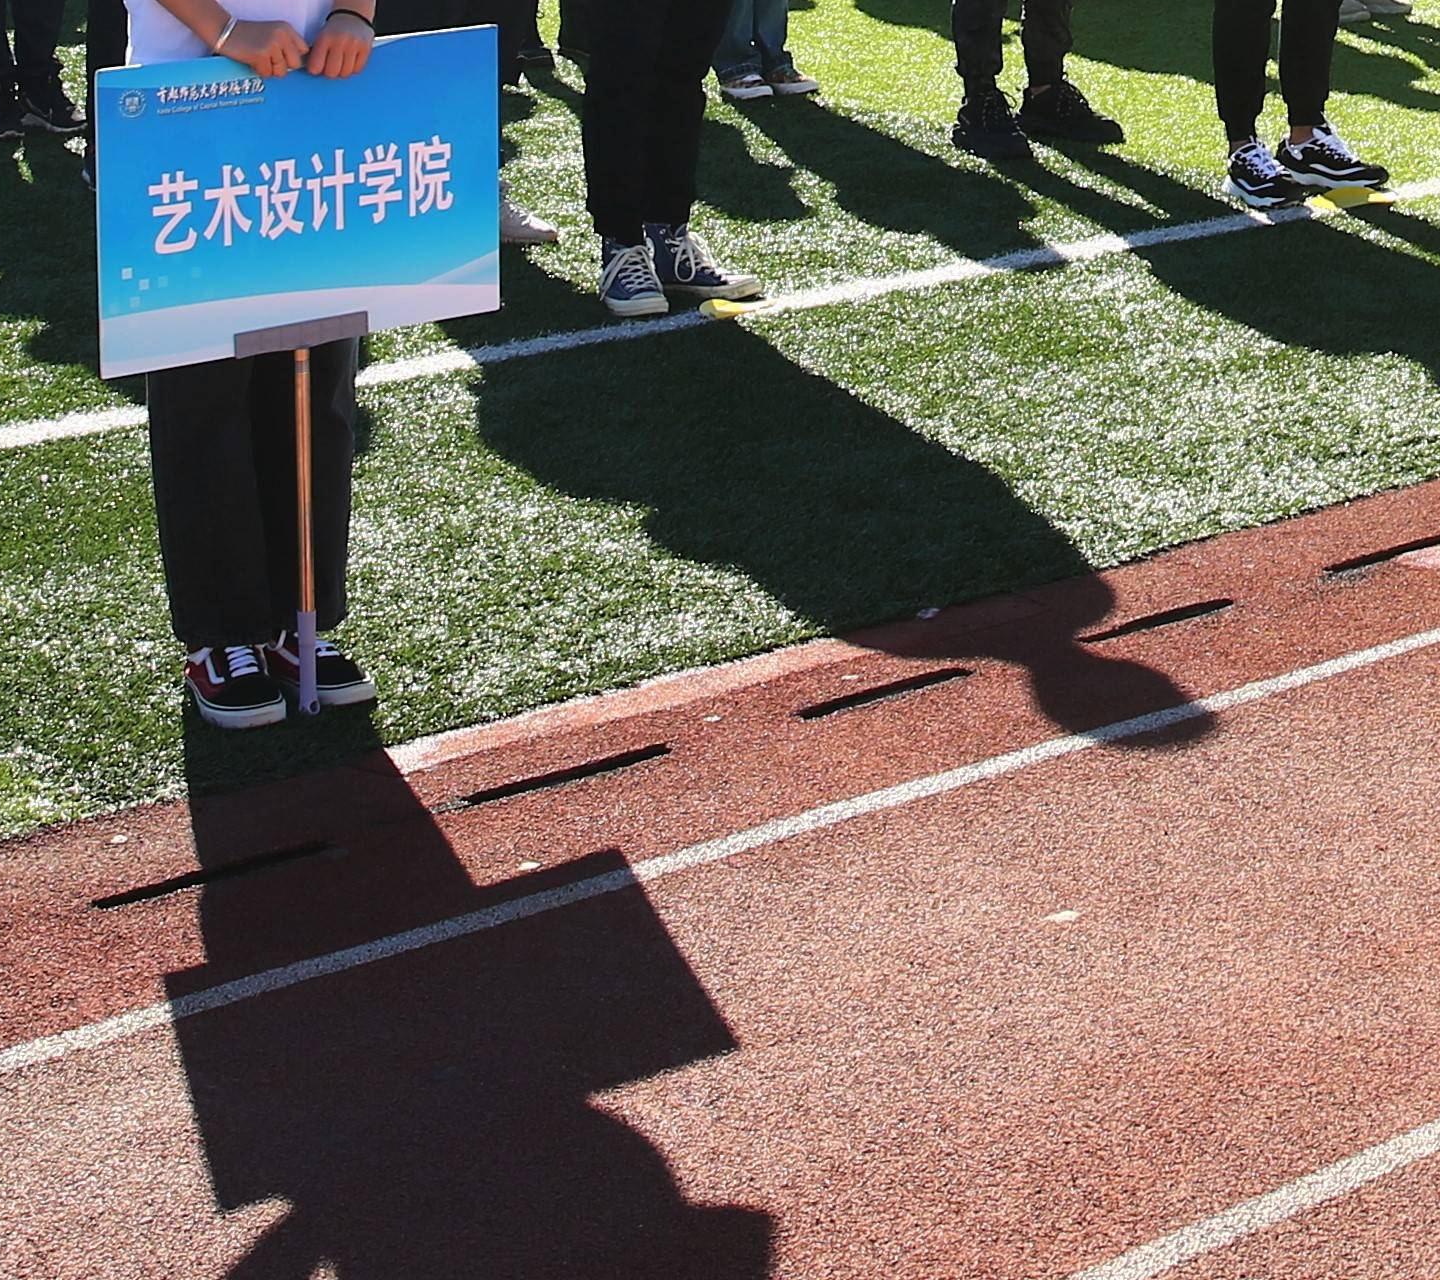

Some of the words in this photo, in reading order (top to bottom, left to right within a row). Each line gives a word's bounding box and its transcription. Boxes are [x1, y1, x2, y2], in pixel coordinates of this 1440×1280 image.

[148, 135, 454, 255] 艺术设计学院
